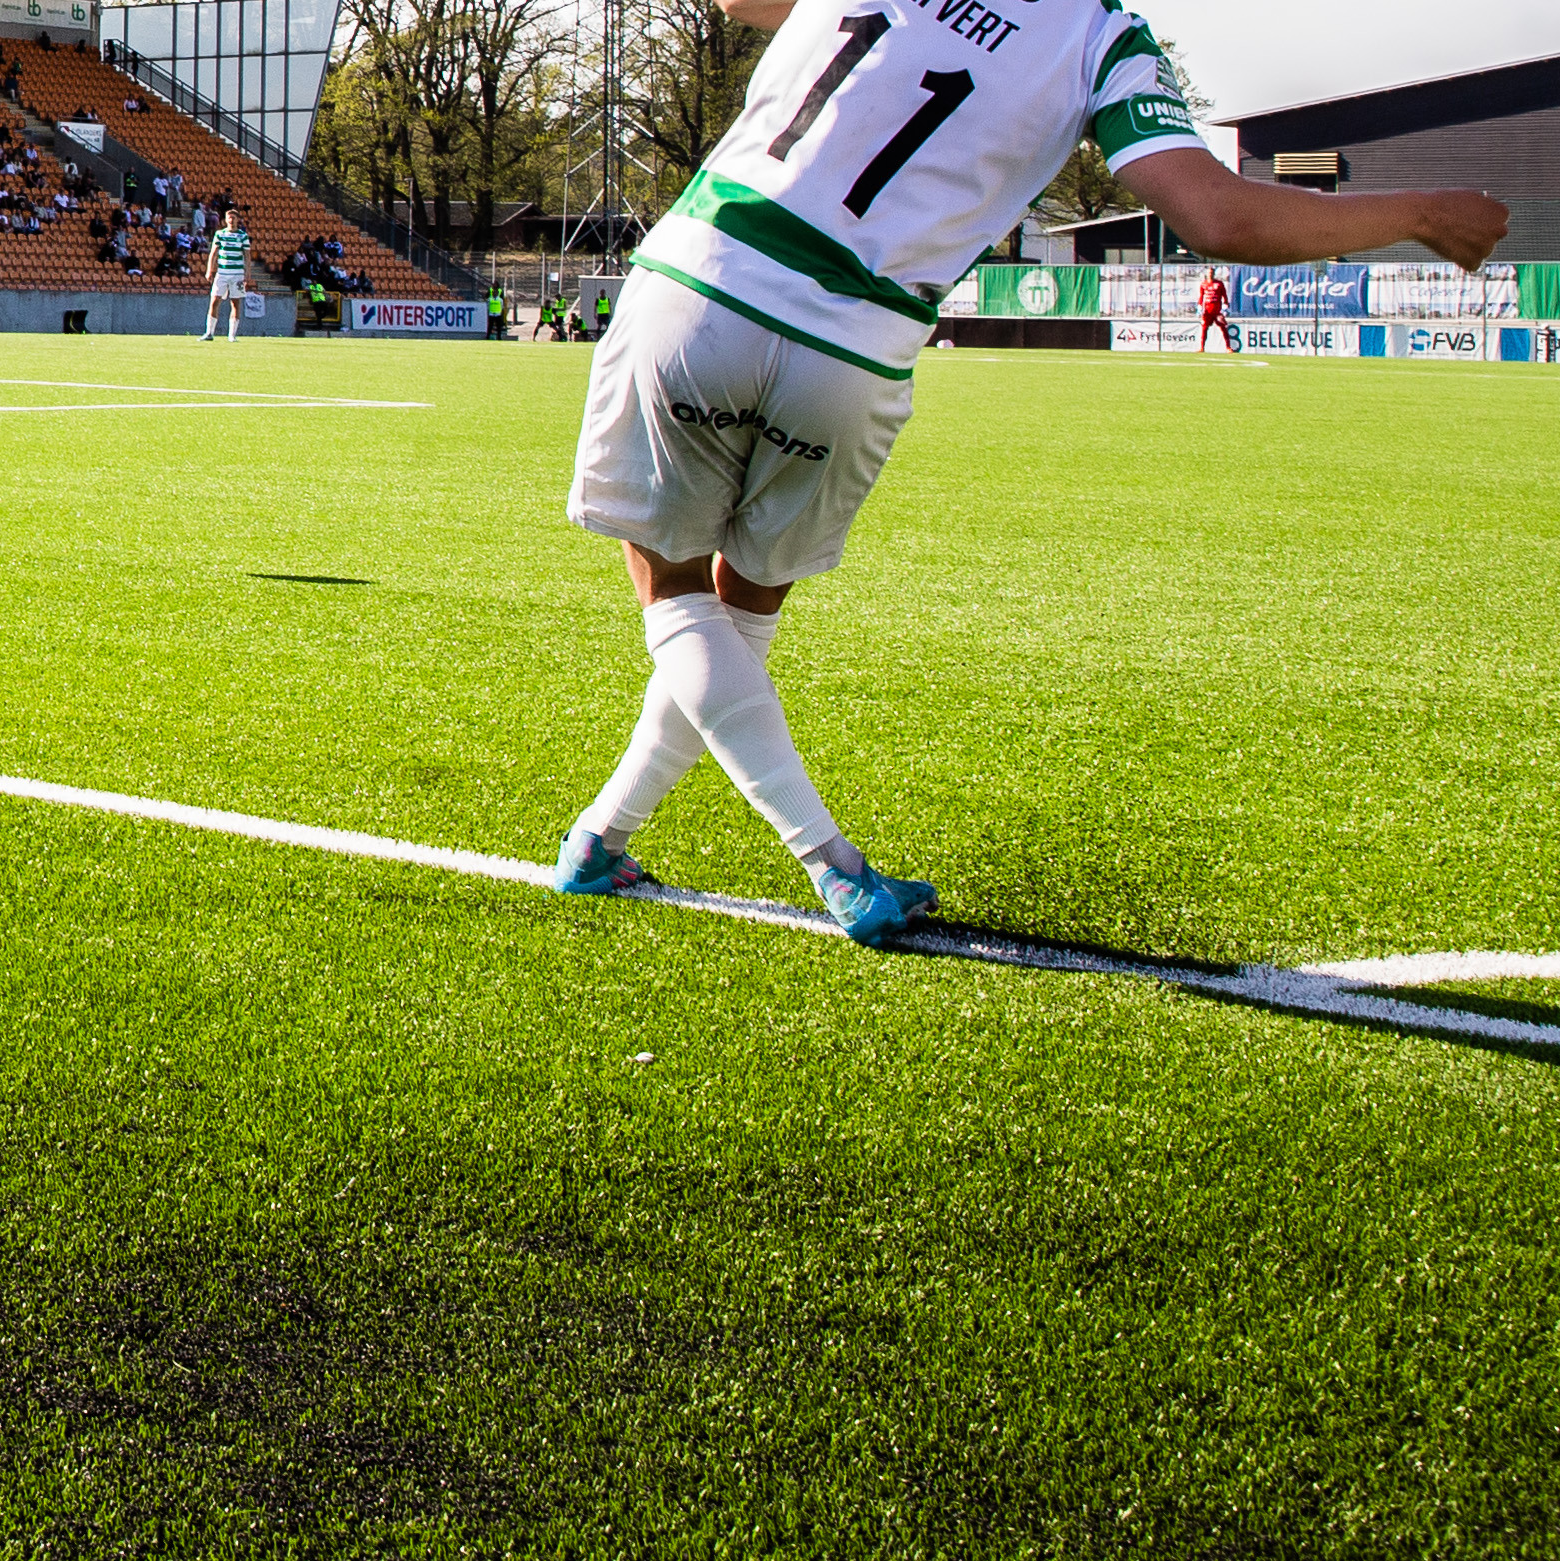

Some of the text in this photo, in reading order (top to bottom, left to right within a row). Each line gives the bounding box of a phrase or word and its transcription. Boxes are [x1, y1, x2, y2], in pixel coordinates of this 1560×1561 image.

[27, 0, 42, 17] tb
[71, 3, 86, 21] tb
[767, 12, 975, 220] 11
[1137, 101, 1191, 122] UNIB
[1241, 274, 1356, 303] Carpenter
[377, 304, 475, 328] INTERSPORT
[1248, 331, 1332, 348] BELLEVUE
[1432, 332, 1476, 351] FVB
